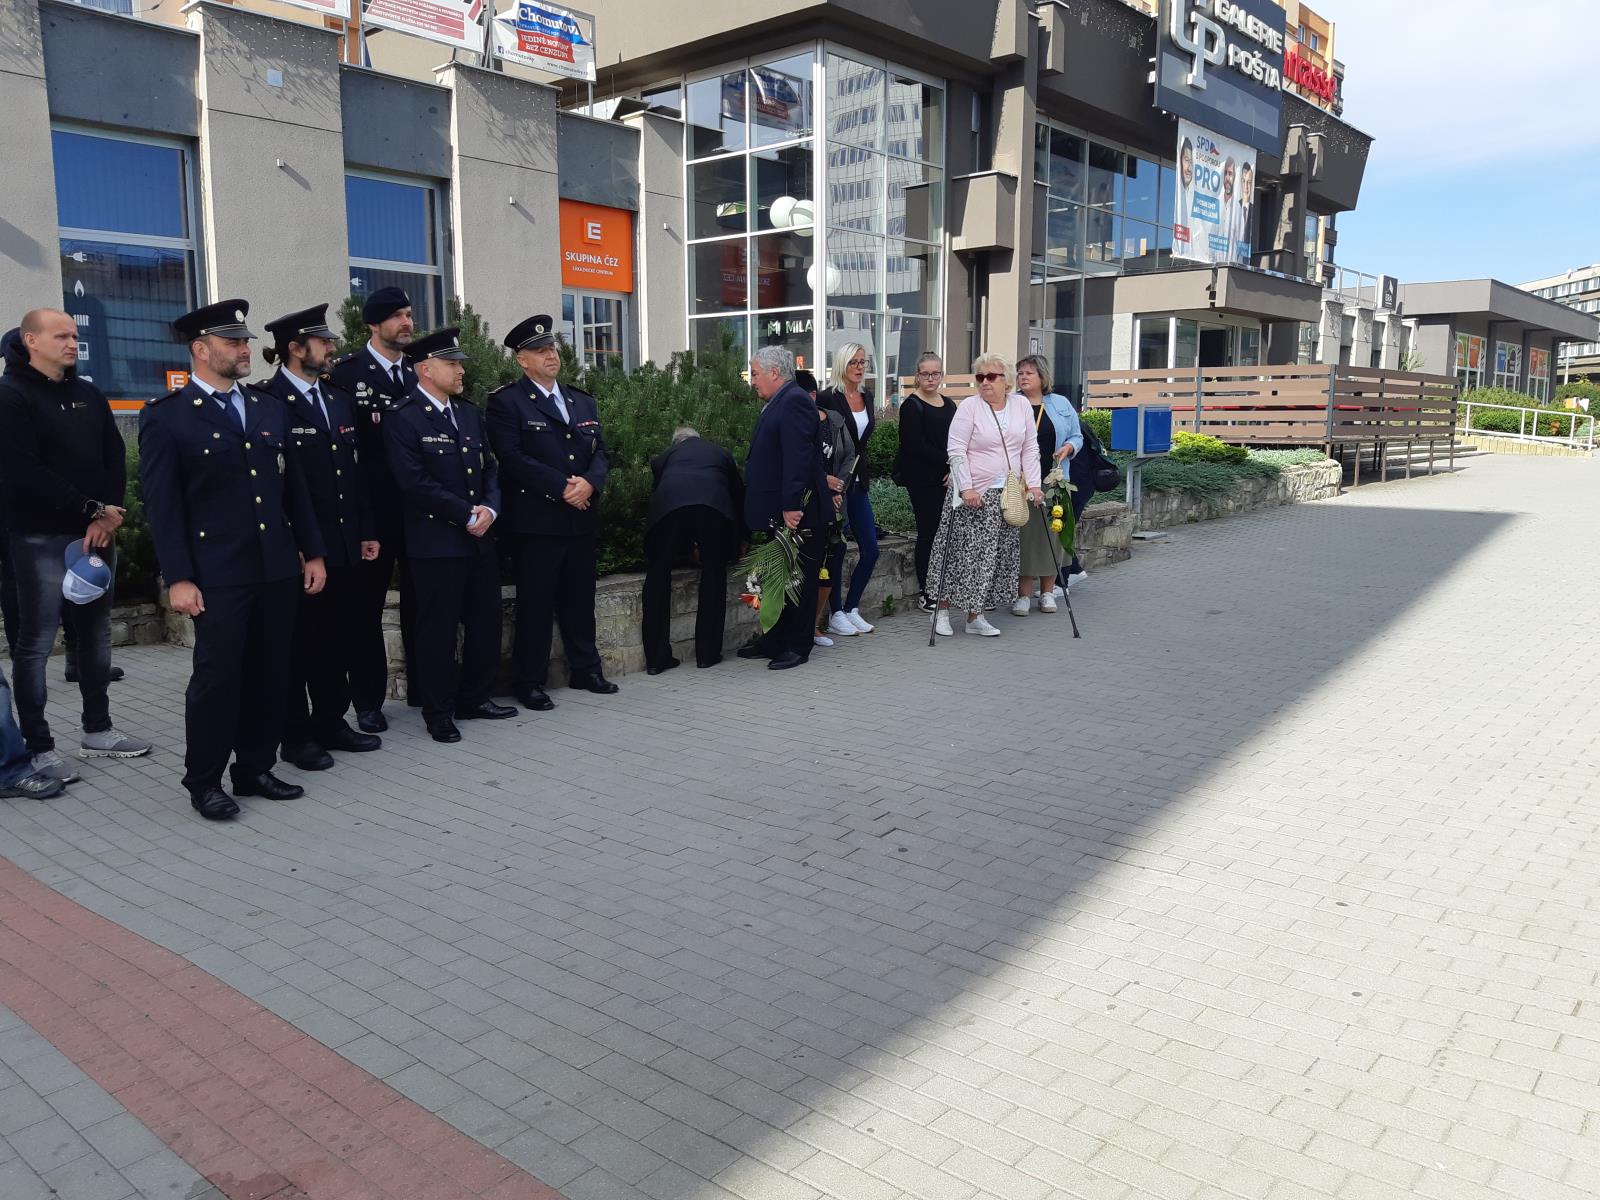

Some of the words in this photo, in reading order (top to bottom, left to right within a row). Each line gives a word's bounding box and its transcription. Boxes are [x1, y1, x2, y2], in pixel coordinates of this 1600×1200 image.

[1215, 0, 1283, 55] GALERIE
[1228, 43, 1281, 92] POŠTA
[1194, 163, 1221, 193] PRO
[565, 251, 602, 264] SKUPINA
[604, 254, 619, 267] ČEZ
[785, 319, 813, 334] MILA
